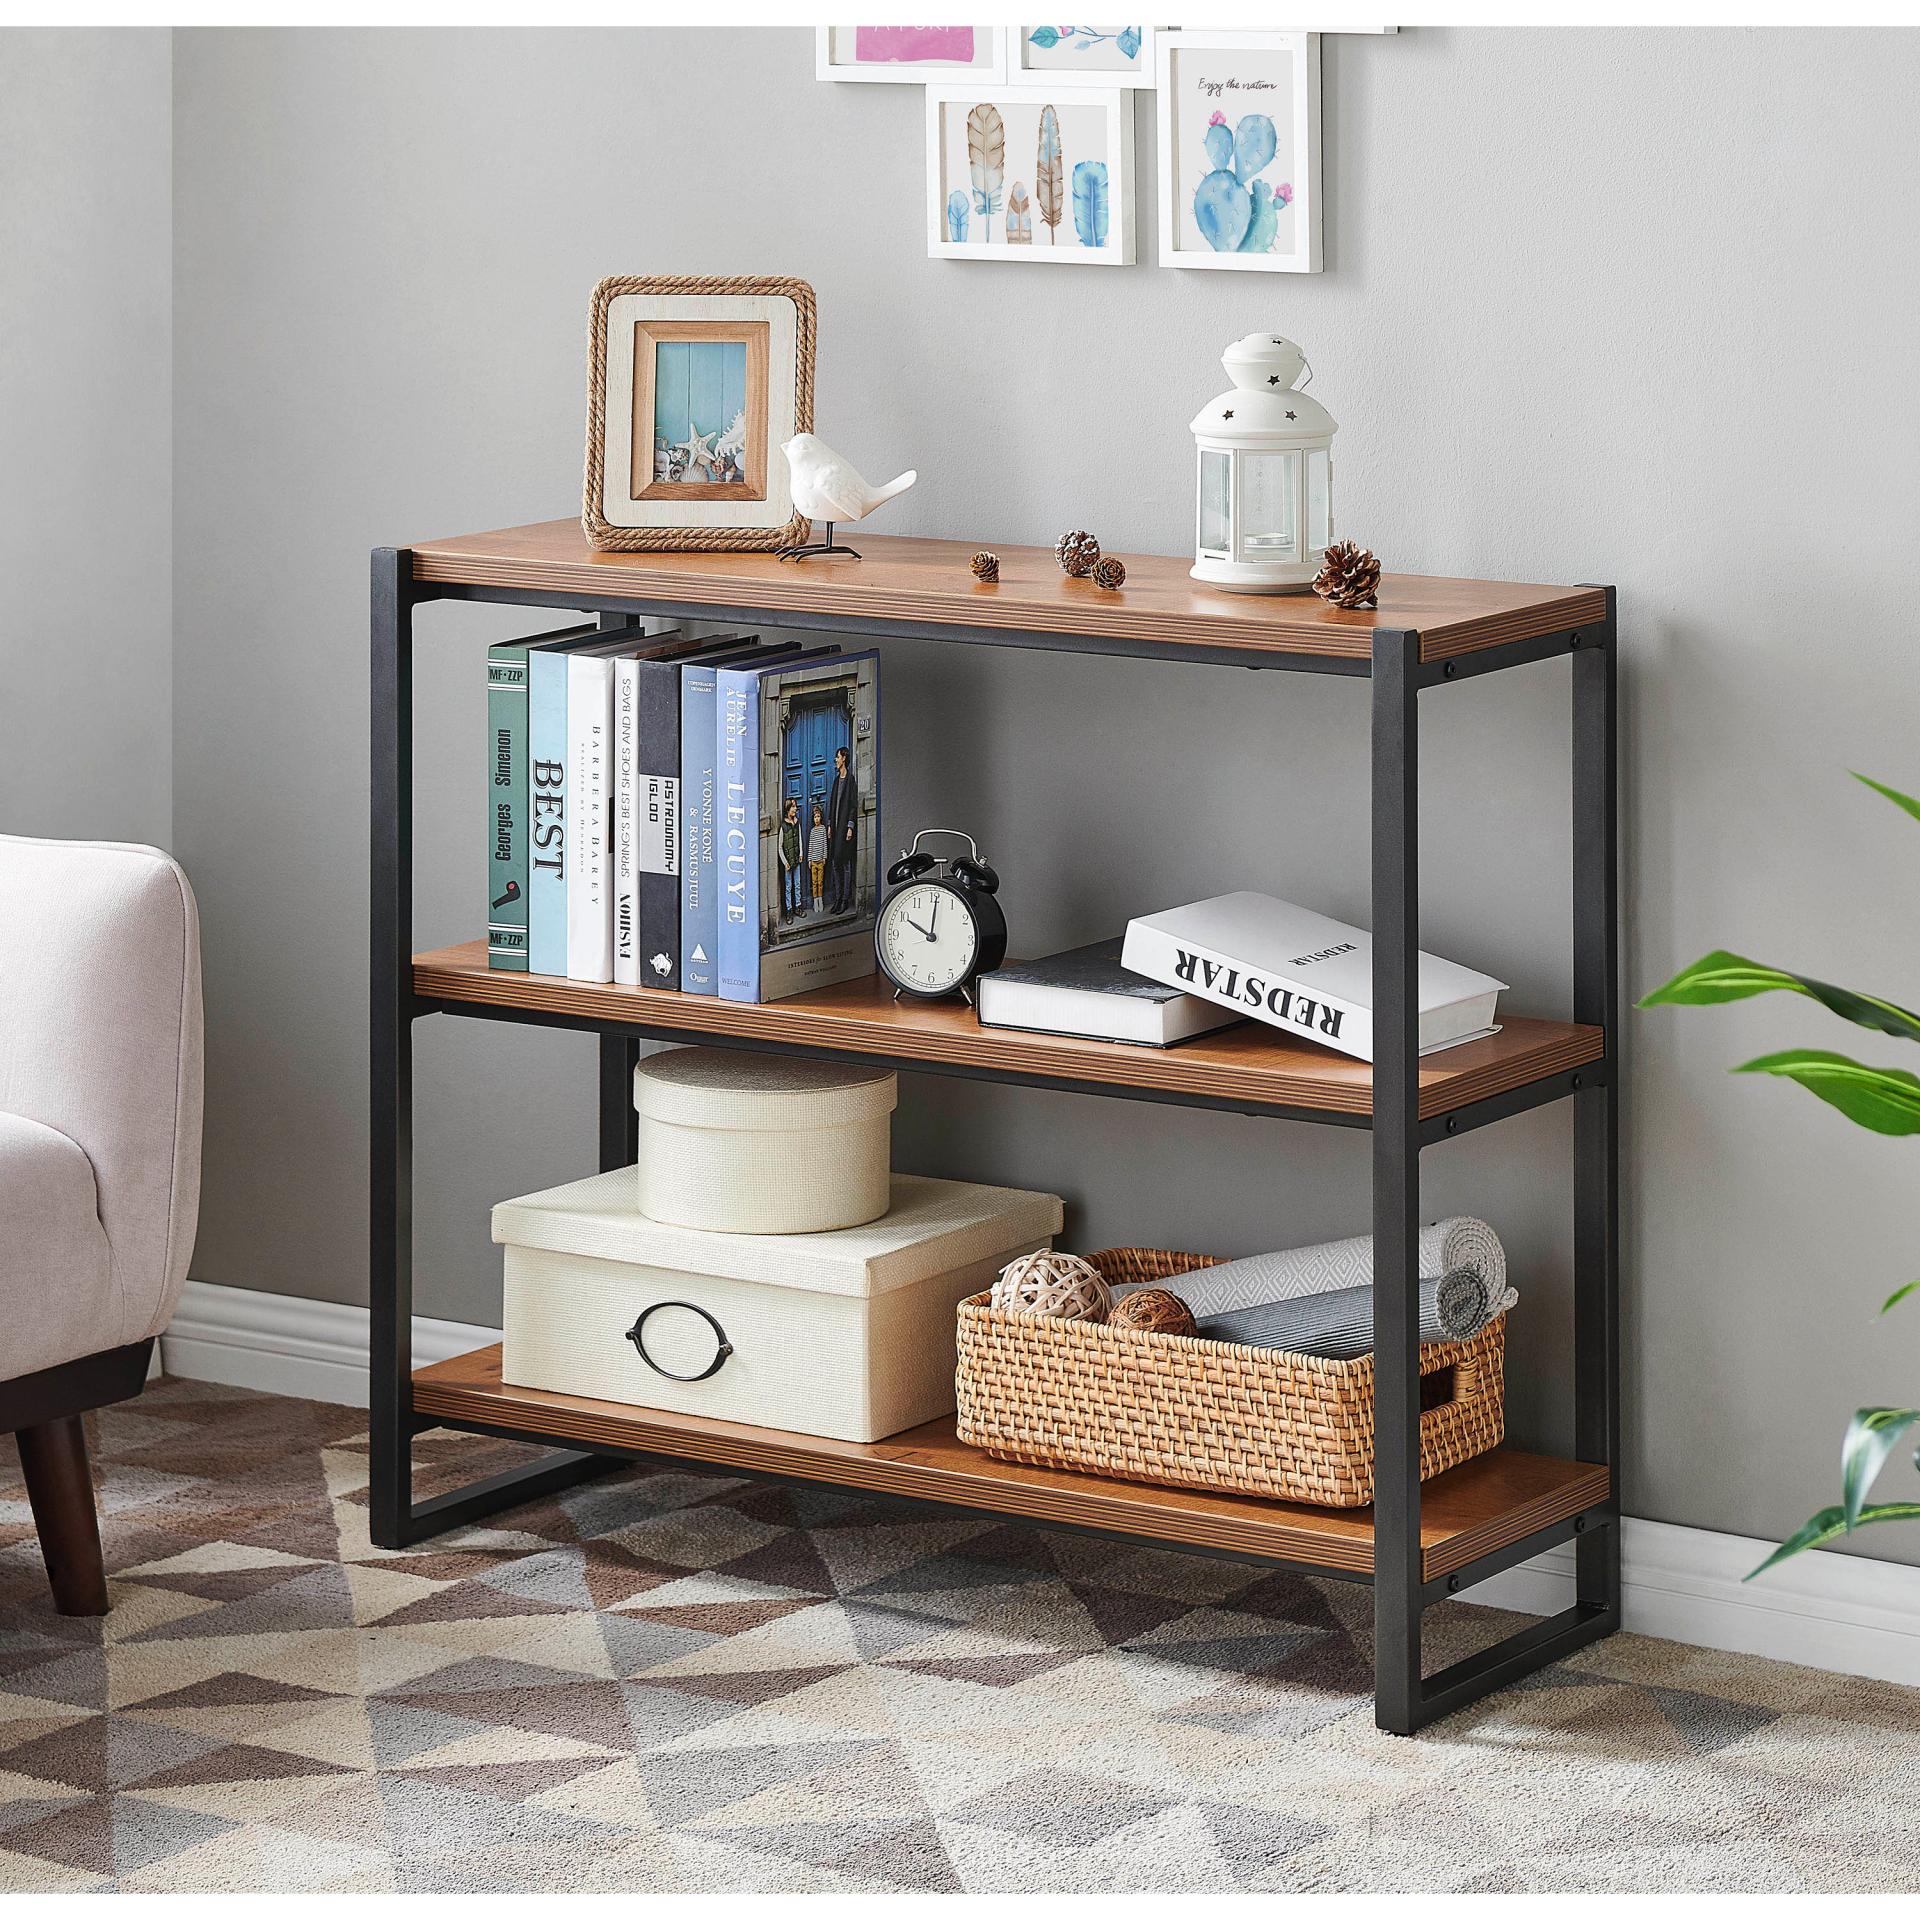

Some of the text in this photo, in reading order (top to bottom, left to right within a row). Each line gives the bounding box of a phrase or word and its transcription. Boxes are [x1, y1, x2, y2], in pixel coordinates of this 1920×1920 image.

[1198, 78, 1223, 97] Enjoy
[1226, 77, 1240, 89] the
[736, 691, 747, 737] JEAN
[726, 687, 736, 767] AURELIE
[860, 720, 869, 730] 20
[494, 729, 513, 861] Georges Simenon
[650, 779, 658, 822] IGLOO
[532, 758, 564, 881] BEST
[620, 678, 631, 958] FASHION SPRING'S BEST SHOES AND BAGS
[665, 780, 673, 872] ASTRONOMY
[727, 780, 746, 923] LECUYE
[689, 807, 699, 910] & RASMUS JUUL
[913, 897, 921, 909] 11
[930, 892, 940, 904] 12
[950, 899, 954, 910] 1
[900, 911, 909, 922] 10
[962, 914, 969, 925] 2
[892, 929, 899, 940] 9
[968, 935, 974, 946] 3
[898, 950, 905, 961] 8
[960, 954, 966, 965] 4
[1288, 943, 1358, 966] REDSTAR
[912, 965, 918, 976] 7
[947, 969, 954, 980] 5
[928, 972, 935, 983] 6
[1175, 949, 1346, 1039] REDSTAR
